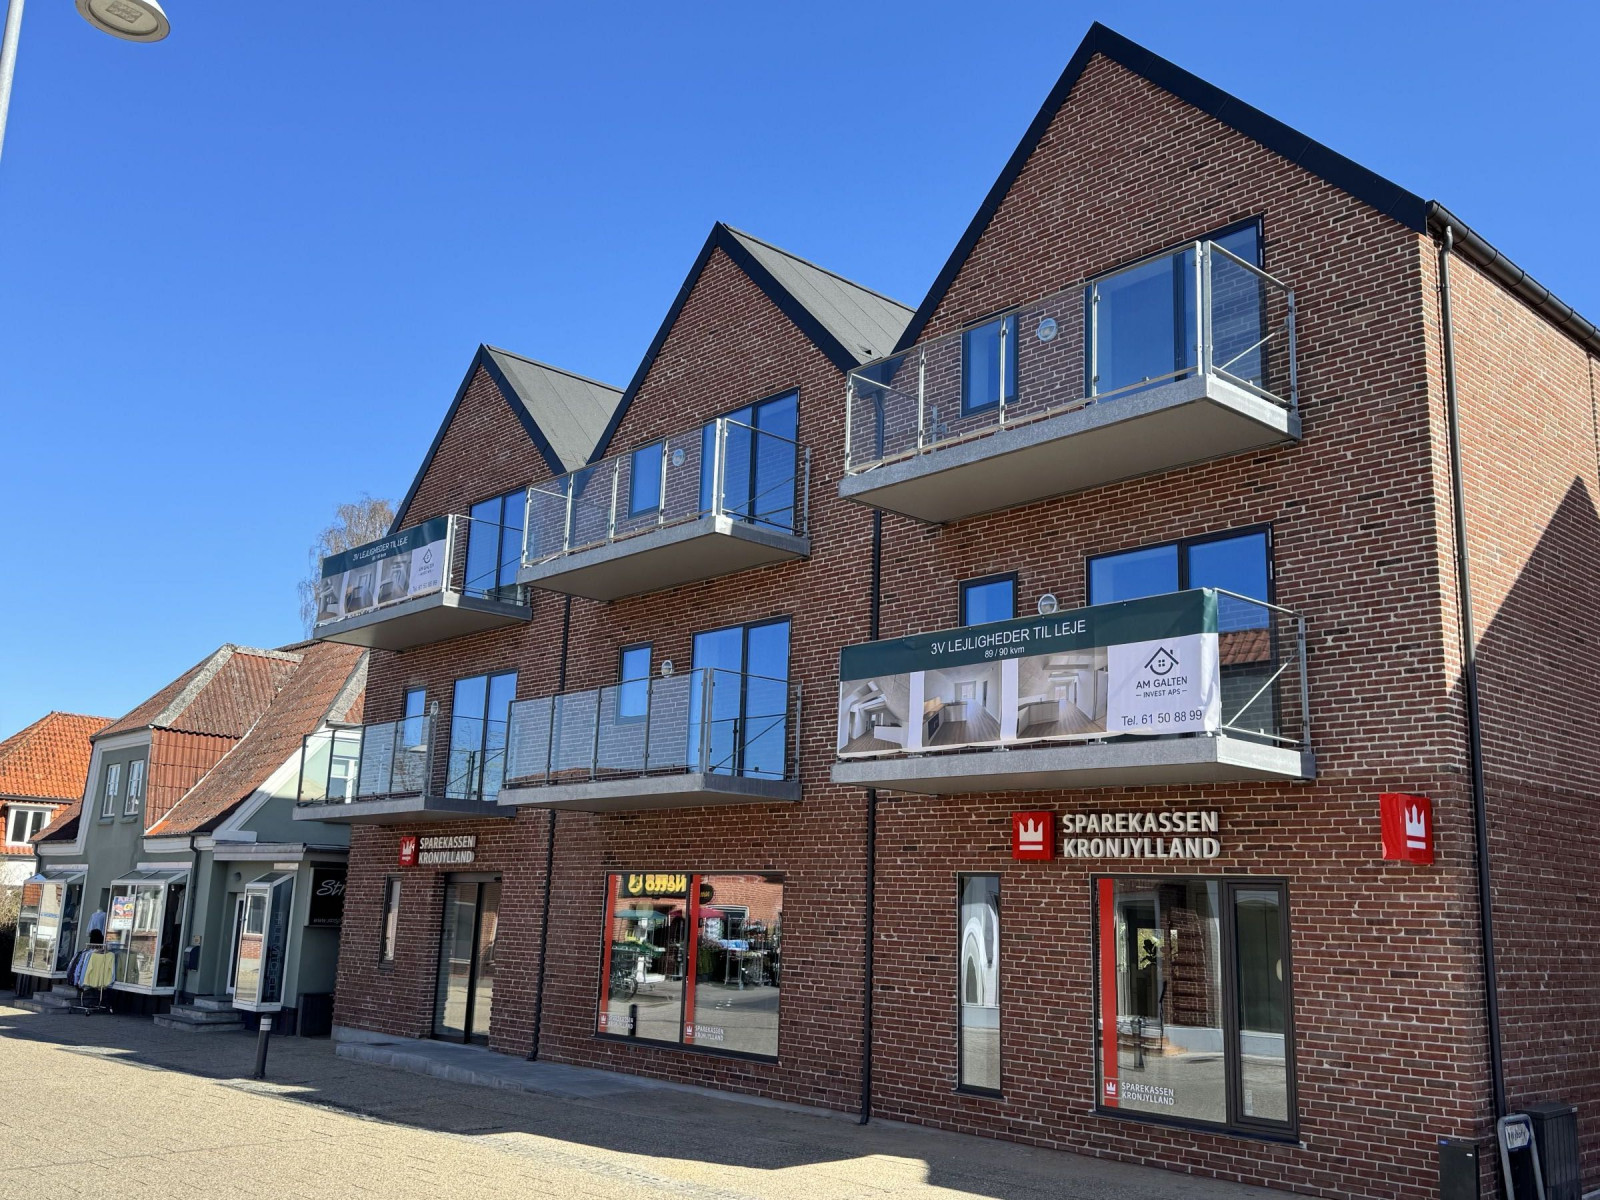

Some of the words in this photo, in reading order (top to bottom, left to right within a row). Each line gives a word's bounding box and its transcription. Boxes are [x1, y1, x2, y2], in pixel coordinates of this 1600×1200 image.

[930, 641, 946, 655] 3V
[948, 628, 1030, 653] LEJLIGHEDER
[1033, 626, 1052, 640] TIL
[1054, 619, 1086, 637] LEJE
[984, 649, 994, 658] 89
[999, 647, 1008, 656] 90
[1009, 645, 1025, 654] kvm
[1135, 680, 1151, 690] AM
[1153, 676, 1188, 688] GALTEN
[1143, 689, 1166, 698] INVEST
[1167, 688, 1181, 696] APS
[1121, 715, 1139, 726] Tel.
[1141, 713, 1153, 725] 61
[1157, 712, 1171, 724] 50
[1174, 711, 1187, 722] 88
[1189, 709, 1203, 721] 99
[1062, 811, 1219, 833] SPAREKASSEN
[419, 835, 477, 849] SPAREKASSEN
[1063, 837, 1221, 858] KRONJYLLAND
[418, 851, 475, 864] KRONJYLLAND
[1121, 1082, 1174, 1097] SPAREKASSEN
[1121, 1091, 1175, 1106] KRONJYLLAND
